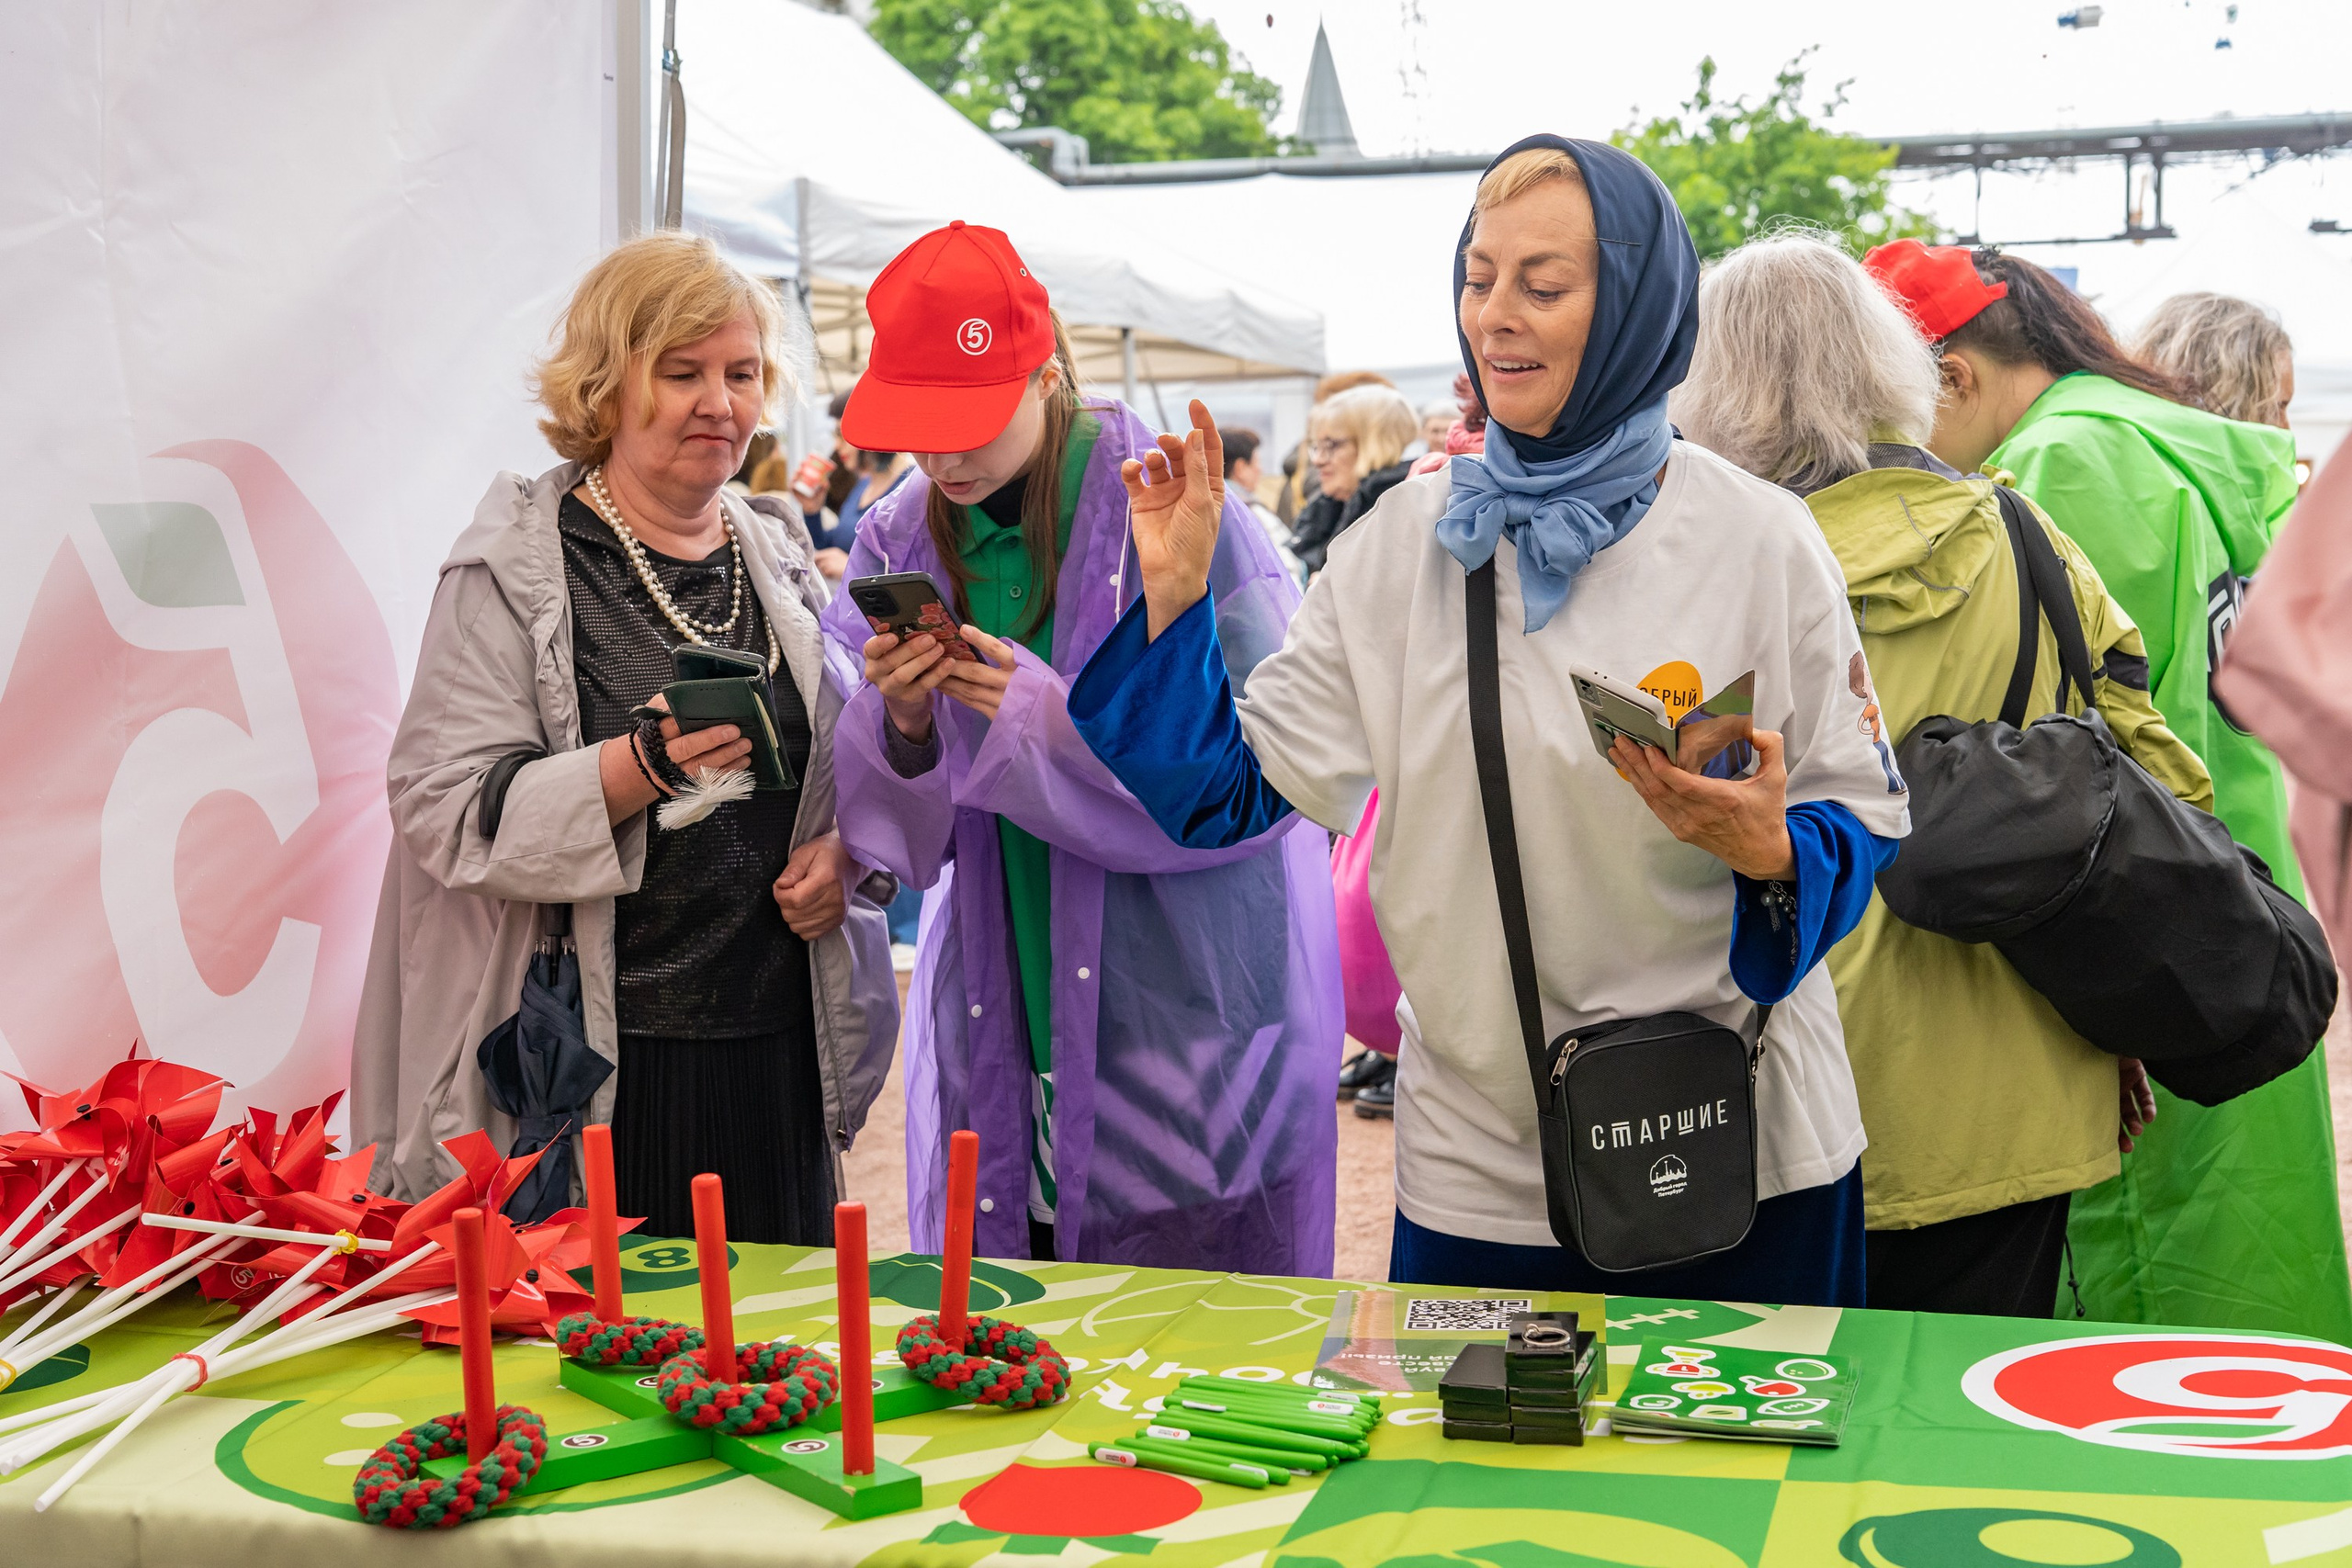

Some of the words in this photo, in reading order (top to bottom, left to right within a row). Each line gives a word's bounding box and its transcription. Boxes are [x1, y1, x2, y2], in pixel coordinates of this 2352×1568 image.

[967, 321, 986, 348] 5
[1639, 687, 1698, 707] БРЫЙ
[1590, 1099, 1728, 1150] СТАРШИЕ
[637, 1247, 691, 1269] 8
